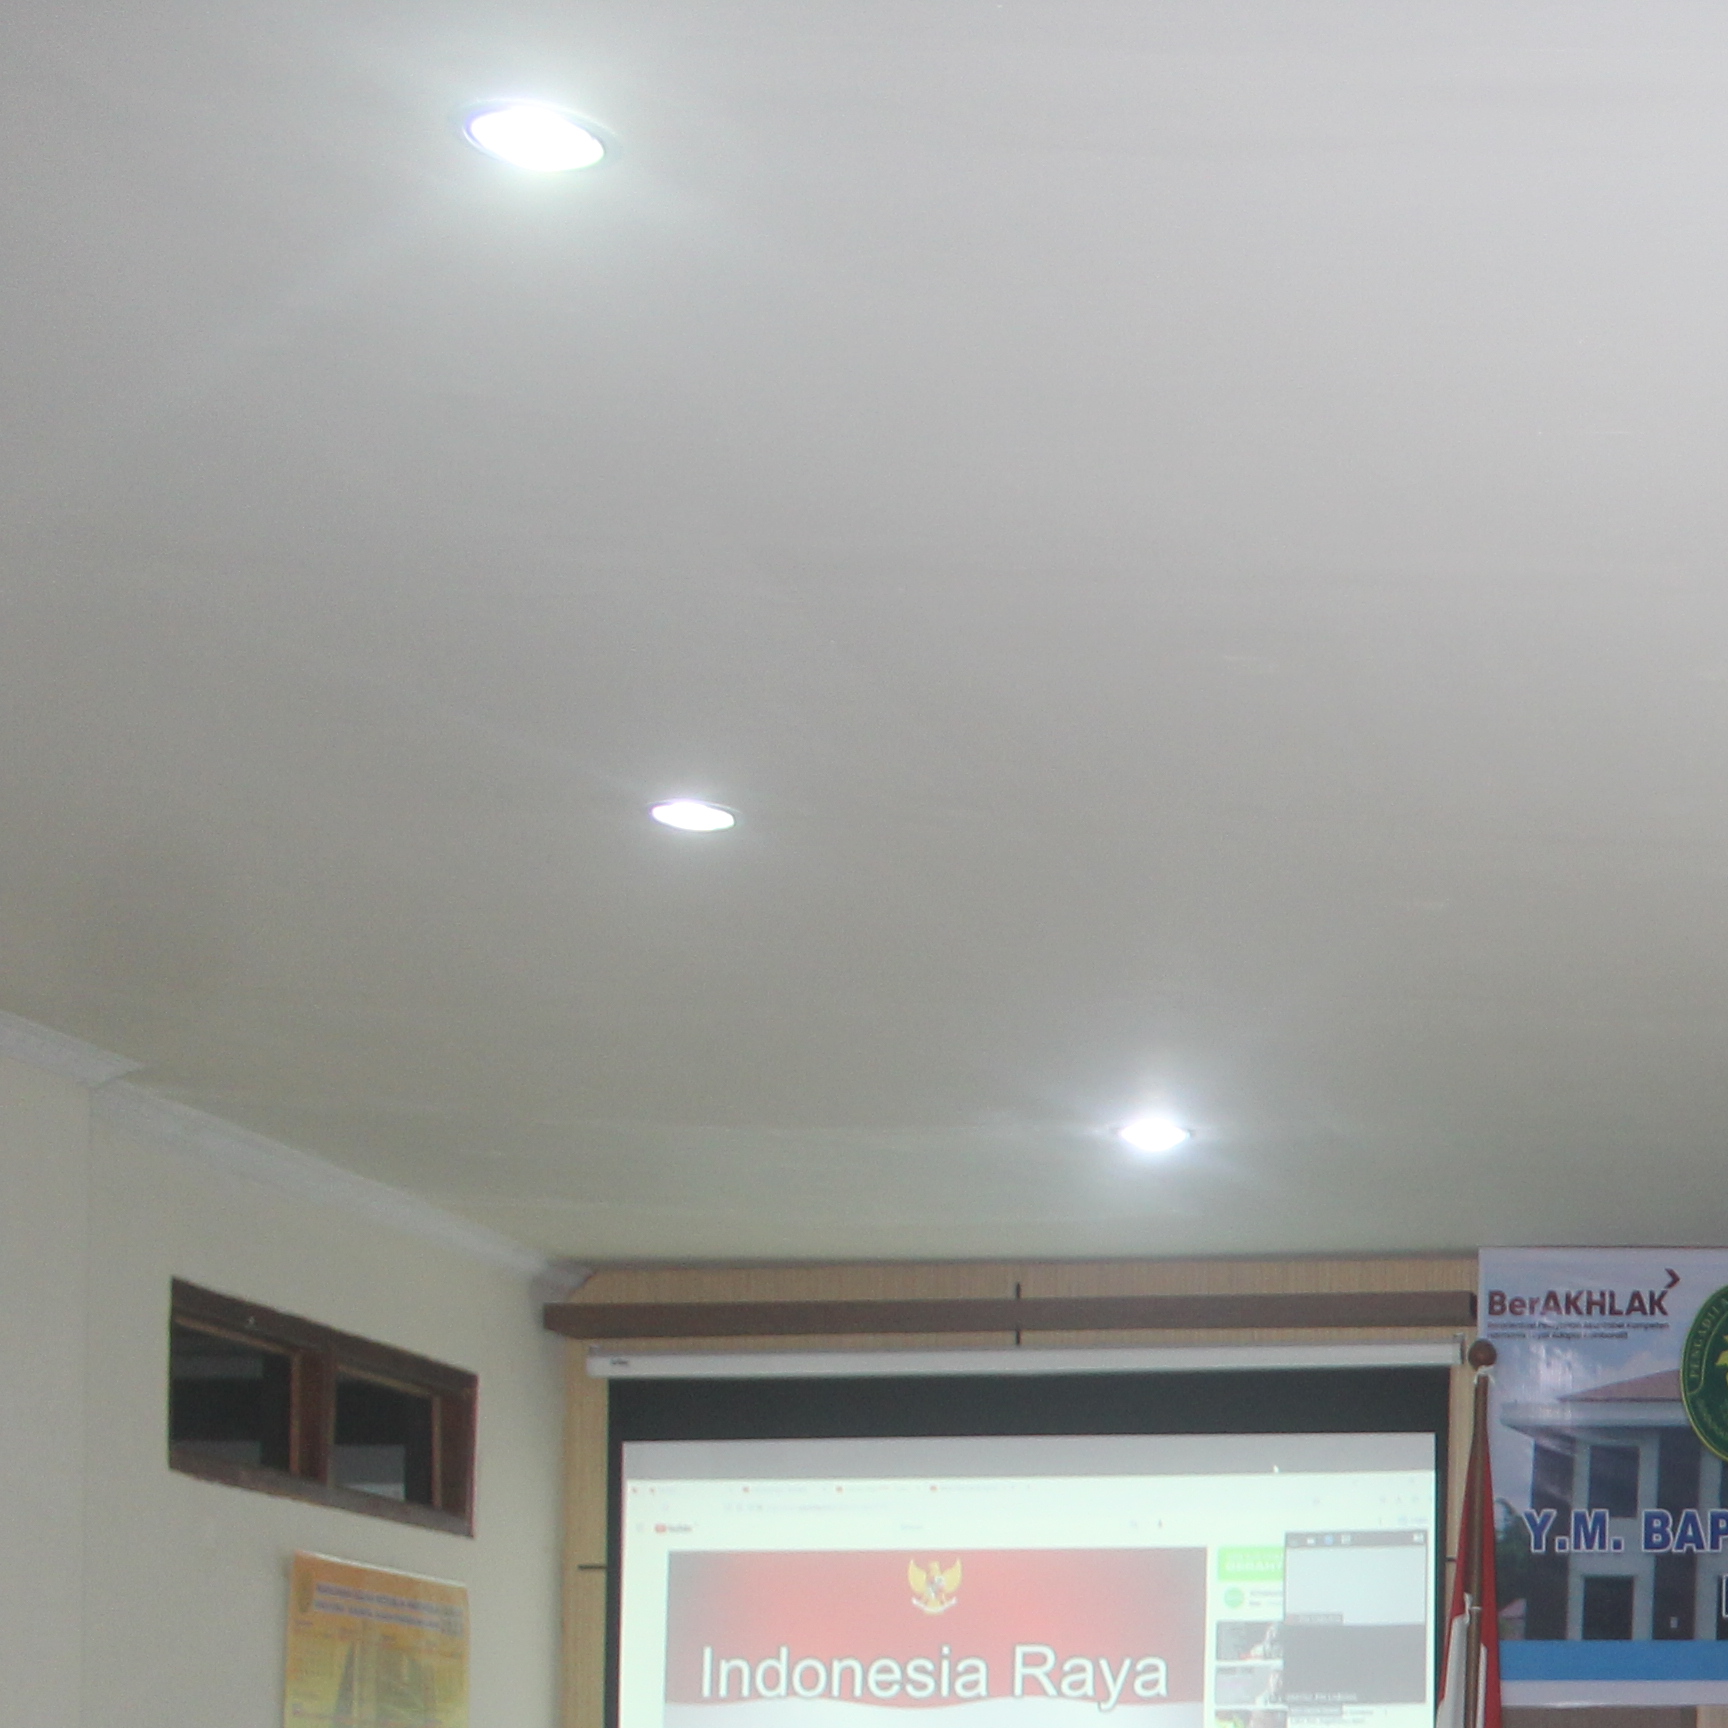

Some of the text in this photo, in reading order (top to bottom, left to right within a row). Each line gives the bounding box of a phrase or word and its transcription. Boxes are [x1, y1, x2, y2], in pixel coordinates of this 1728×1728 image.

[1487, 1290, 1669, 1316] BerAKHLAK
[1522, 1508, 1624, 1553] Y.M.
[700, 1643, 1169, 1713] Indonesia Raya
